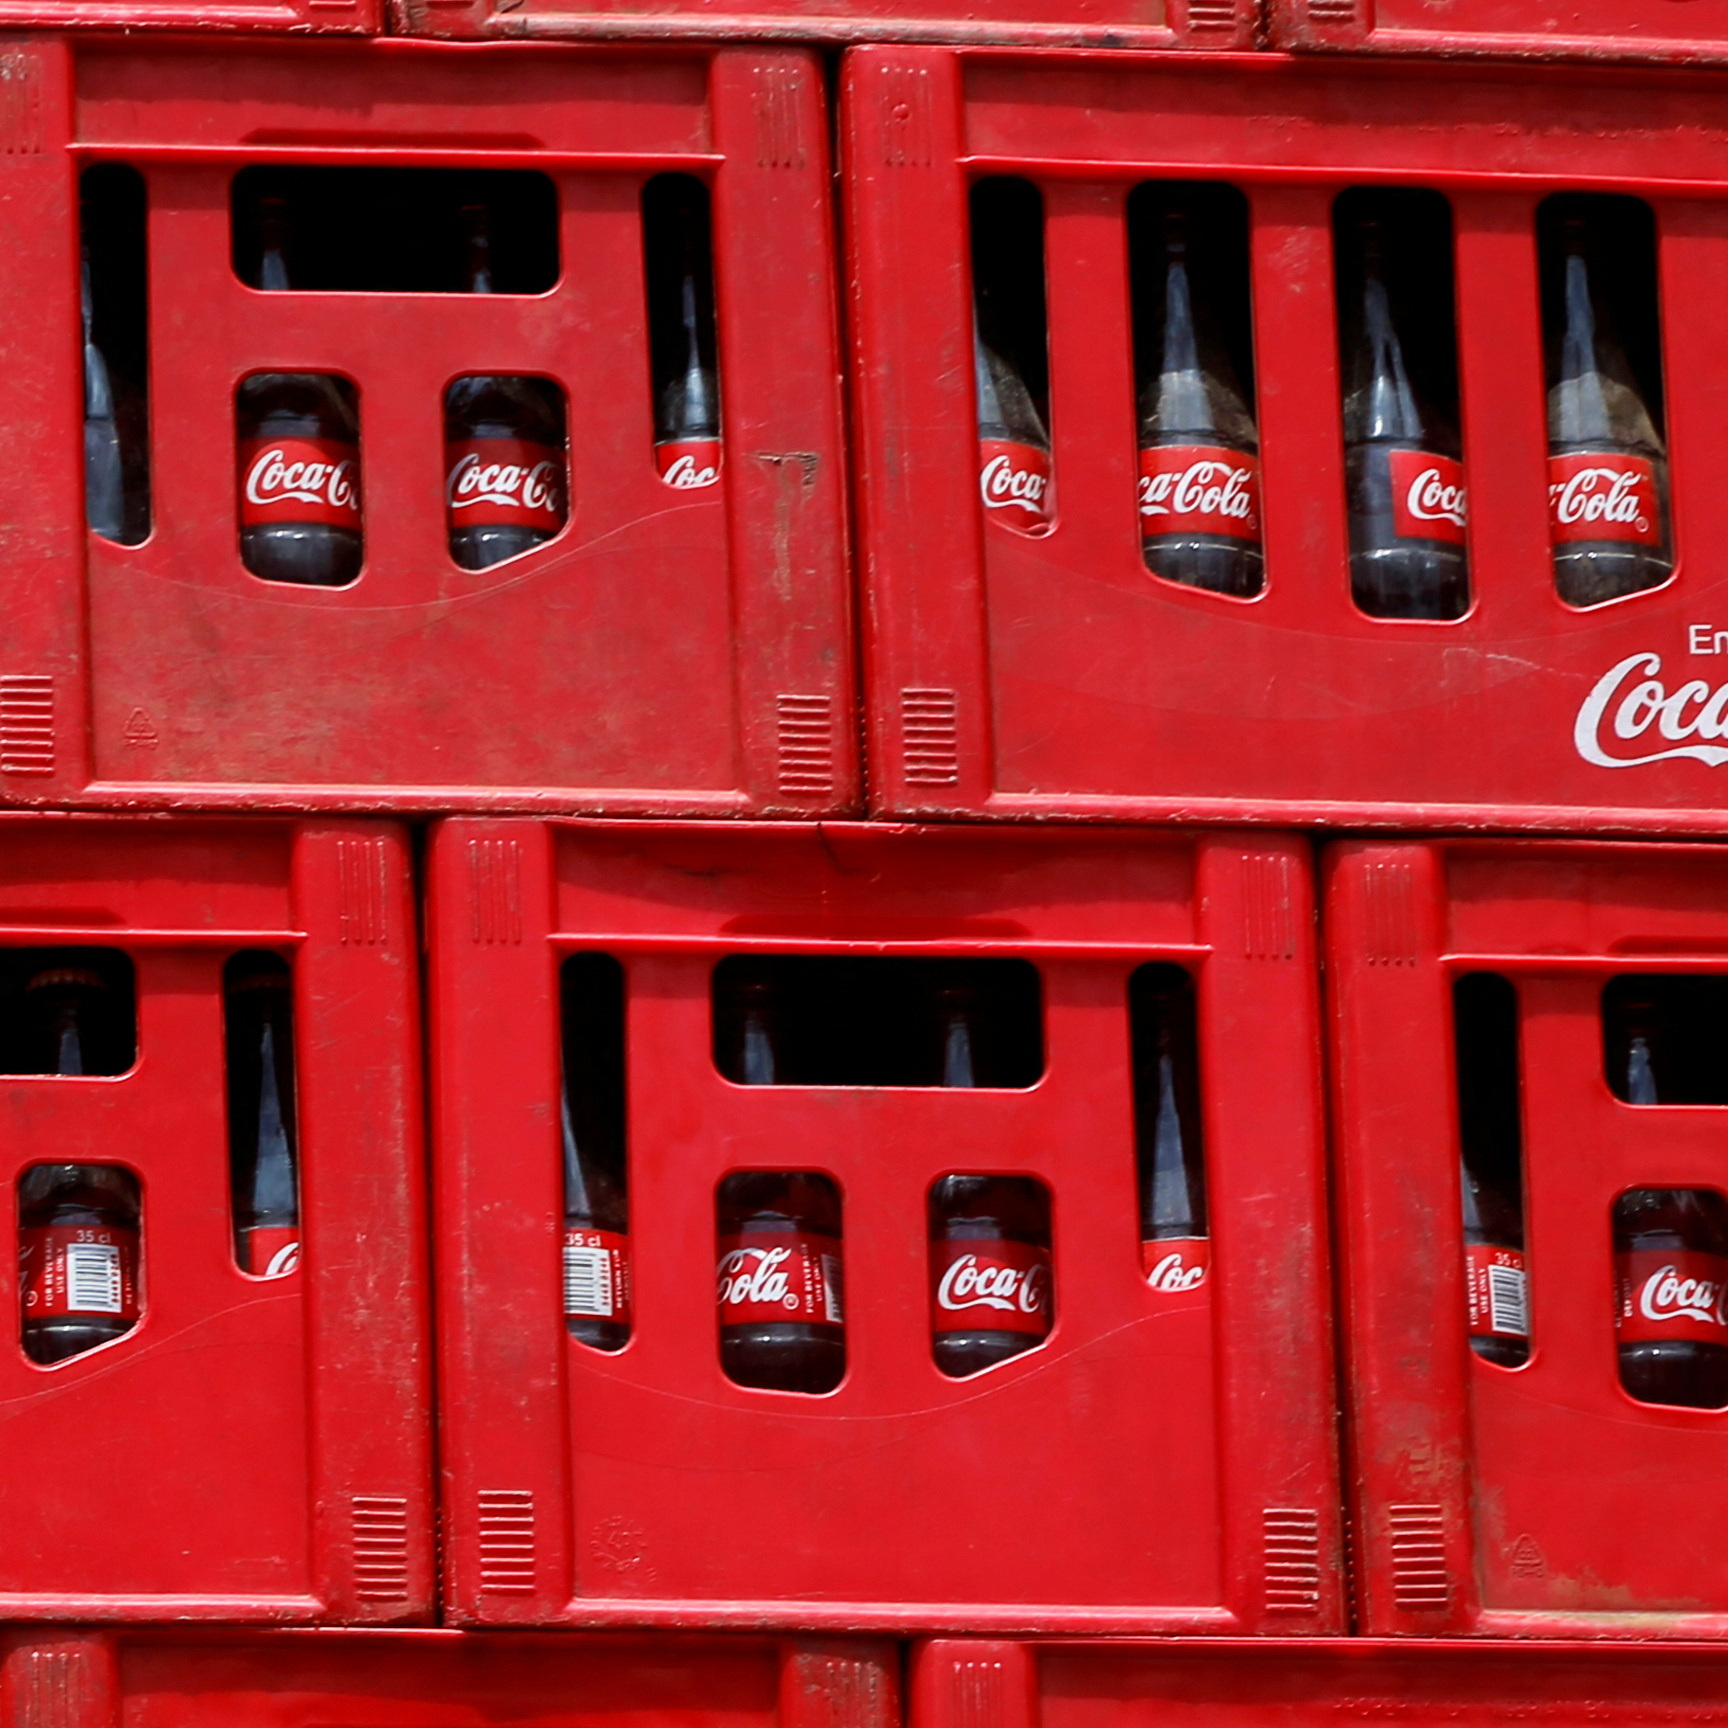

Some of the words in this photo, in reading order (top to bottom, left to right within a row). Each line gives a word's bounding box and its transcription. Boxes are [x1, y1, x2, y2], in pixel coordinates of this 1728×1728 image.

[76, 1230, 95, 1243] 35
[98, 1231, 111, 1245] cl
[564, 1232, 584, 1246] 35
[587, 1234, 602, 1247] cl
[1494, 1252, 1511, 1266] 35
[1466, 1255, 1477, 1304] BEVERAGE
[1478, 1268, 1487, 1293] ONLY
[44, 1286, 53, 1307] FOR
[1479, 1294, 1489, 1314] USE
[1469, 1305, 1479, 1326] FOR
